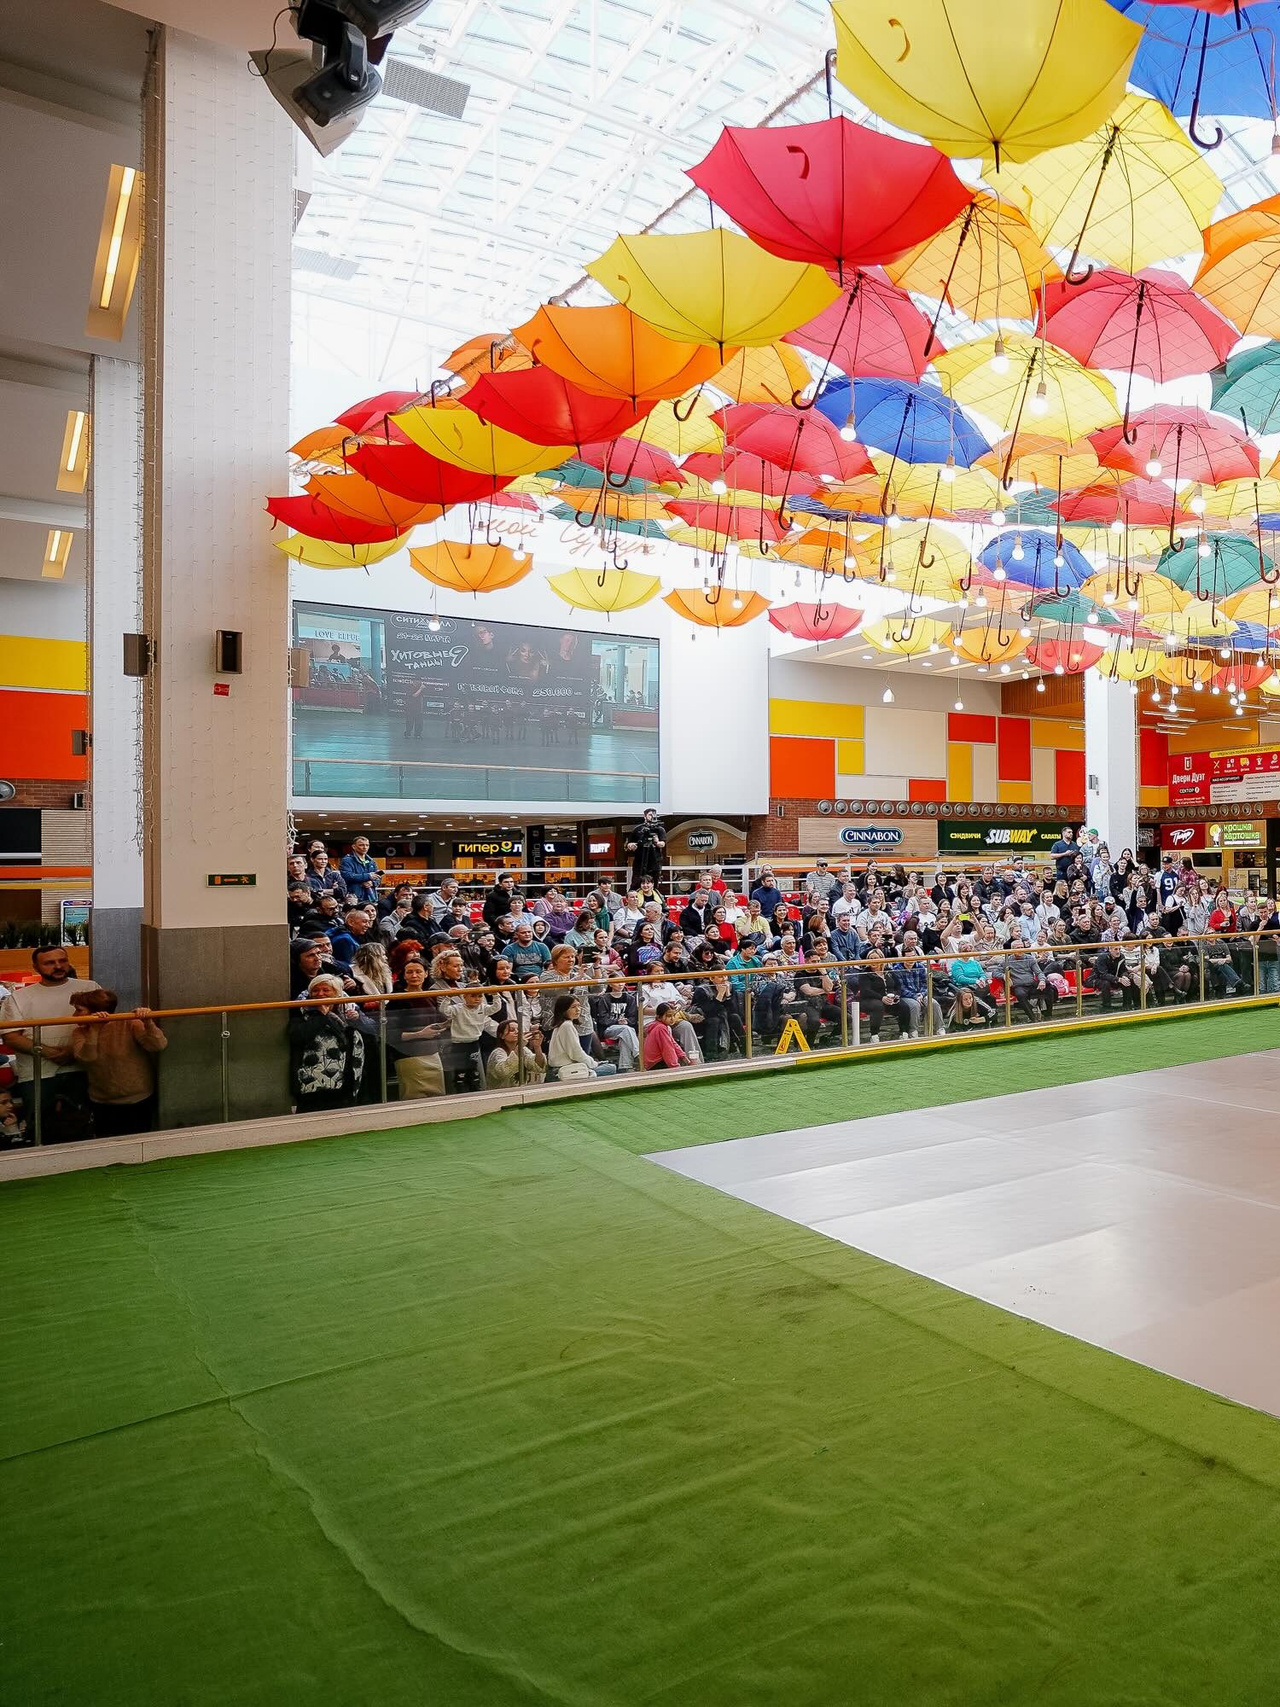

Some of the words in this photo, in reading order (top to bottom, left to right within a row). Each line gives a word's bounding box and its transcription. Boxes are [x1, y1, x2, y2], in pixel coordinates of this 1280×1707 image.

[390, 649, 450, 663] ХИТОВЫЕ
[404, 658, 443, 671] ТАНЦЫ
[1172, 773, 1191, 785] Двери
[1191, 772, 1206, 784] Дуэт
[843, 829, 900, 843] CINNABON
[949, 832, 982, 840] СЭНДВИЧИ
[984, 828, 1038, 844] SUBWAY
[1223, 831, 1261, 841] картошка
[458, 843, 500, 855] гипер
